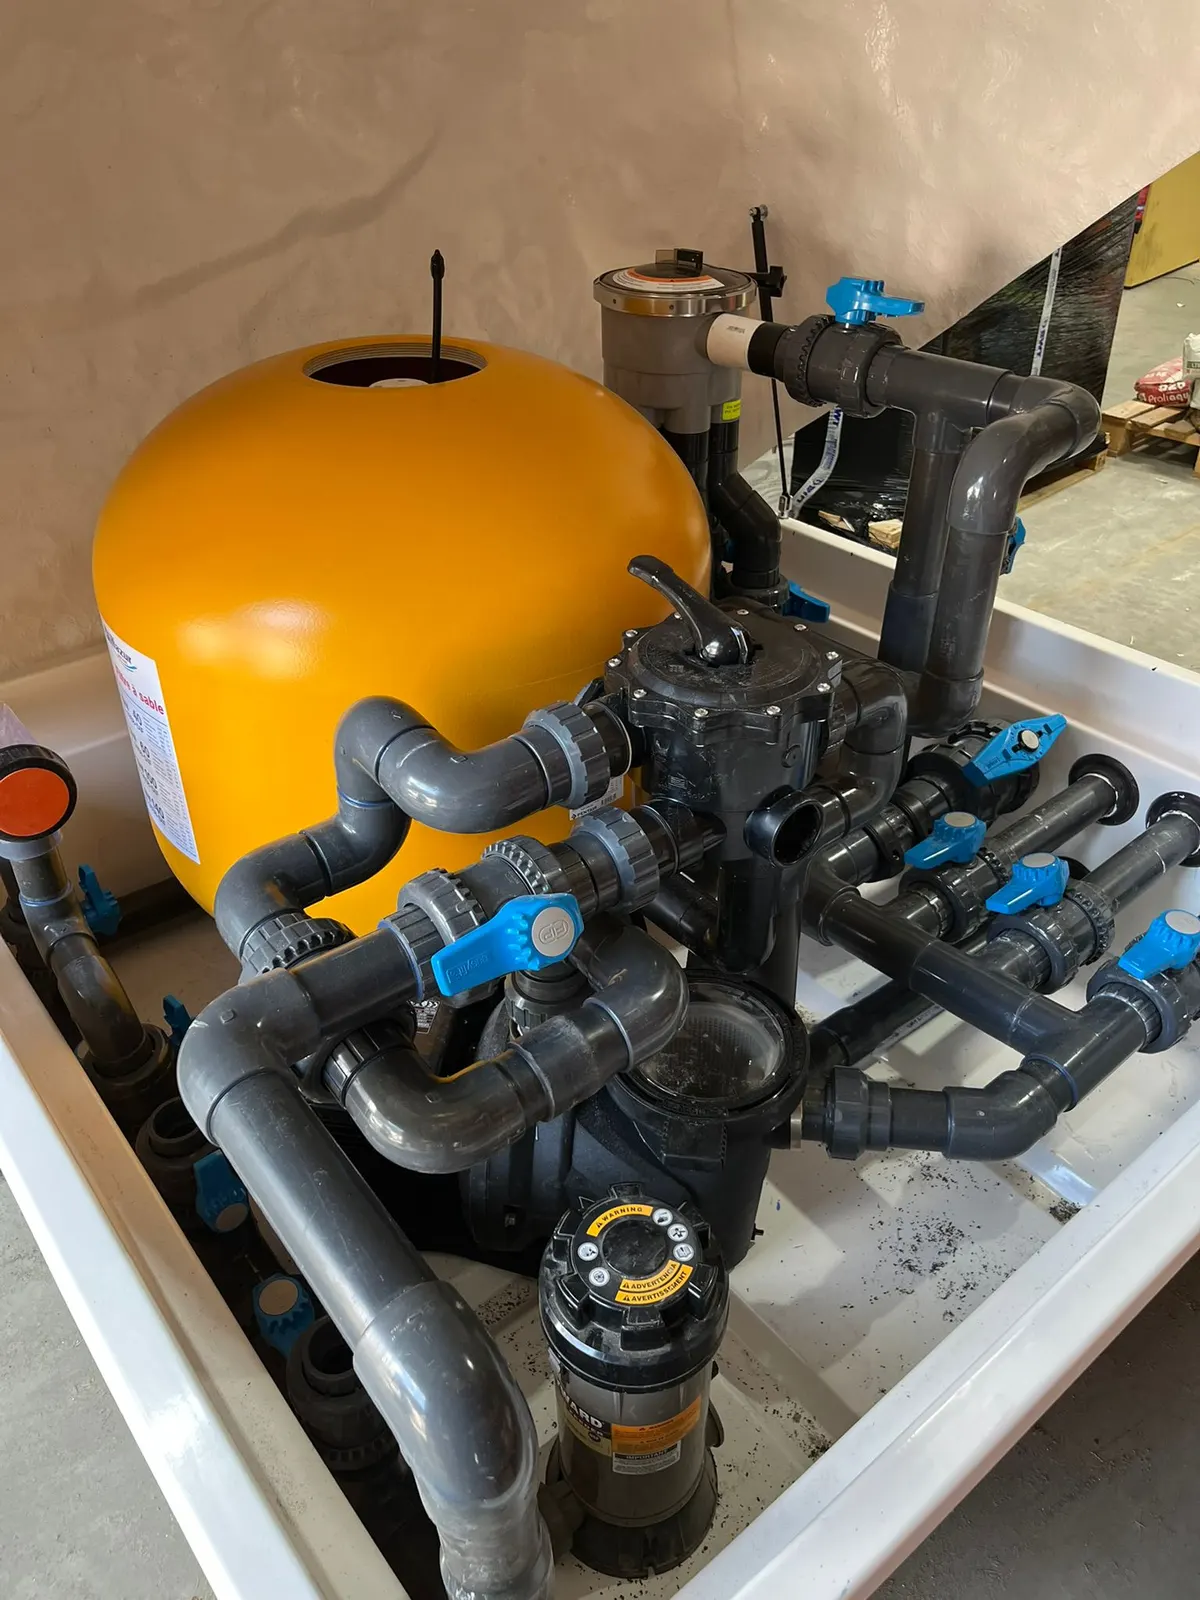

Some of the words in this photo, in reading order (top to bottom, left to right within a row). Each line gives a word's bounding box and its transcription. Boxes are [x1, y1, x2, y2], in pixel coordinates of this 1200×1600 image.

[139, 692, 164, 715] sable
[602, 1206, 643, 1222] WARNING
[631, 1263, 677, 1290] ADVERTENCIA
[631, 1271, 687, 1302] AVERTISSEMENT
